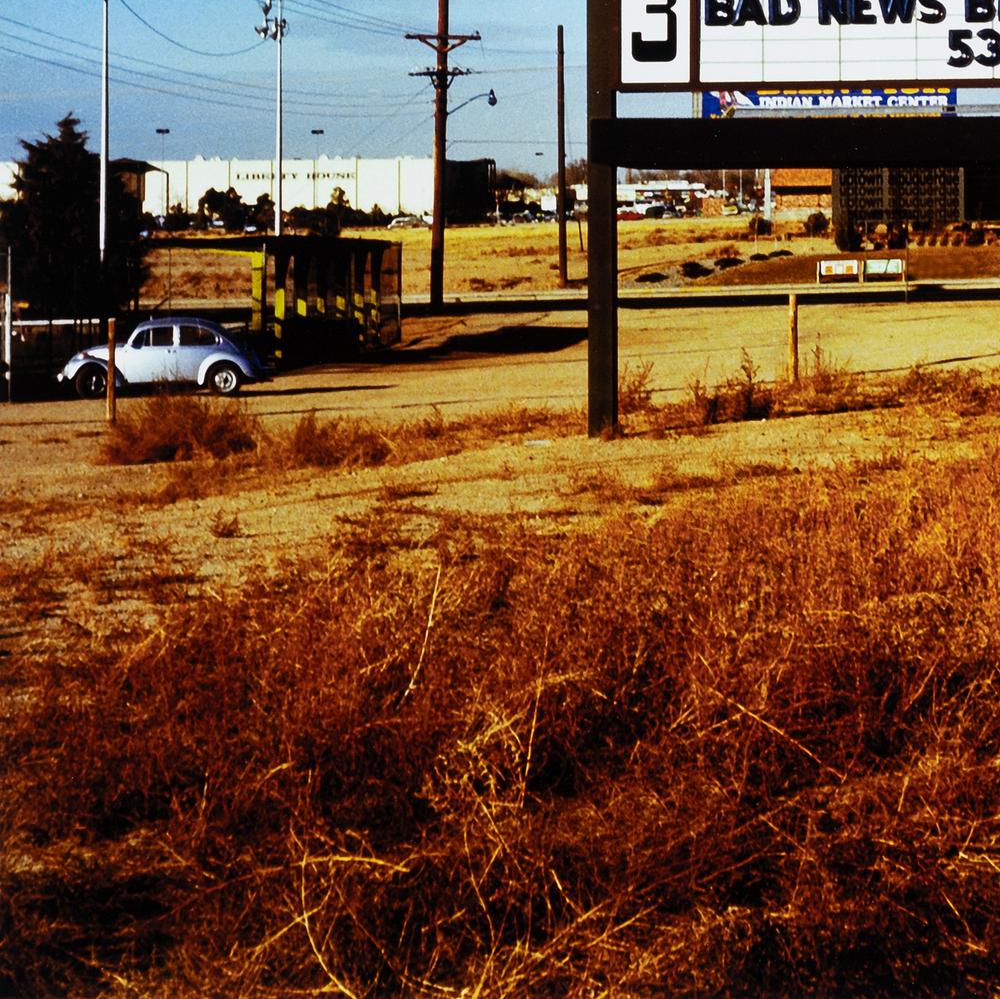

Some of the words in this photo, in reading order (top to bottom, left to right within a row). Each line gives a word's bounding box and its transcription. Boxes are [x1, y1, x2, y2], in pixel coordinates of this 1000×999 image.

[759, 96, 813, 109] INDIAN
[819, 96, 883, 108] MARKET
[887, 95, 949, 107] CENTER
